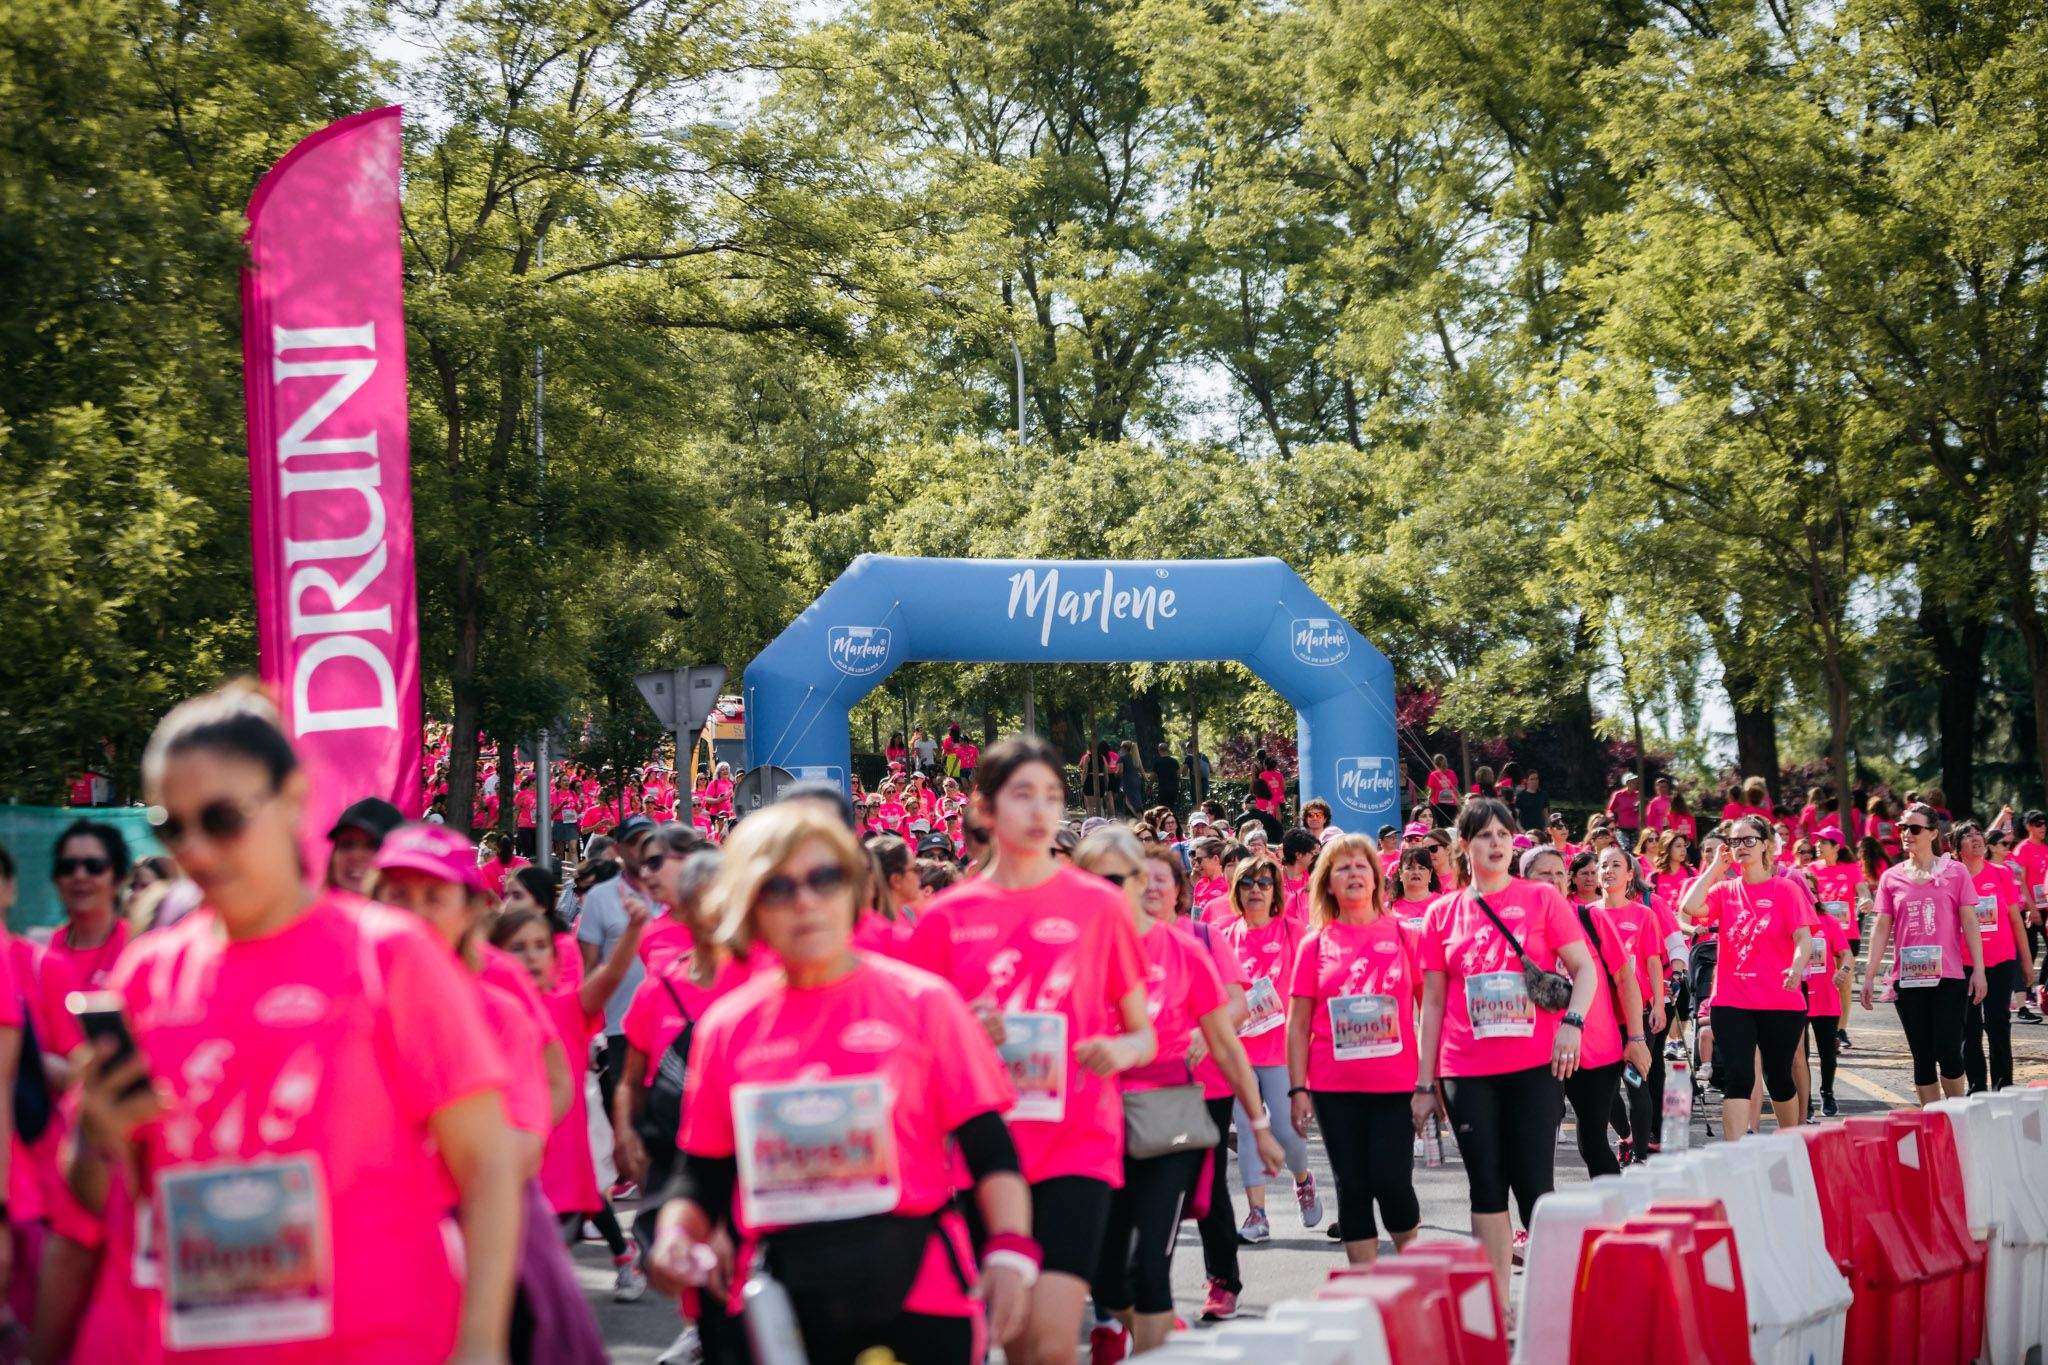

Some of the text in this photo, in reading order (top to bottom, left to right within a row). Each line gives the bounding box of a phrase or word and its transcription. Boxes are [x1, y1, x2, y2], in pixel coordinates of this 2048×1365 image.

[273, 321, 398, 740] DRUNI
[1008, 569, 1177, 647] Marlene
[833, 637, 887, 662] Marlene
[1296, 629, 1346, 654] Marlene
[1342, 769, 1394, 798] Marlene
